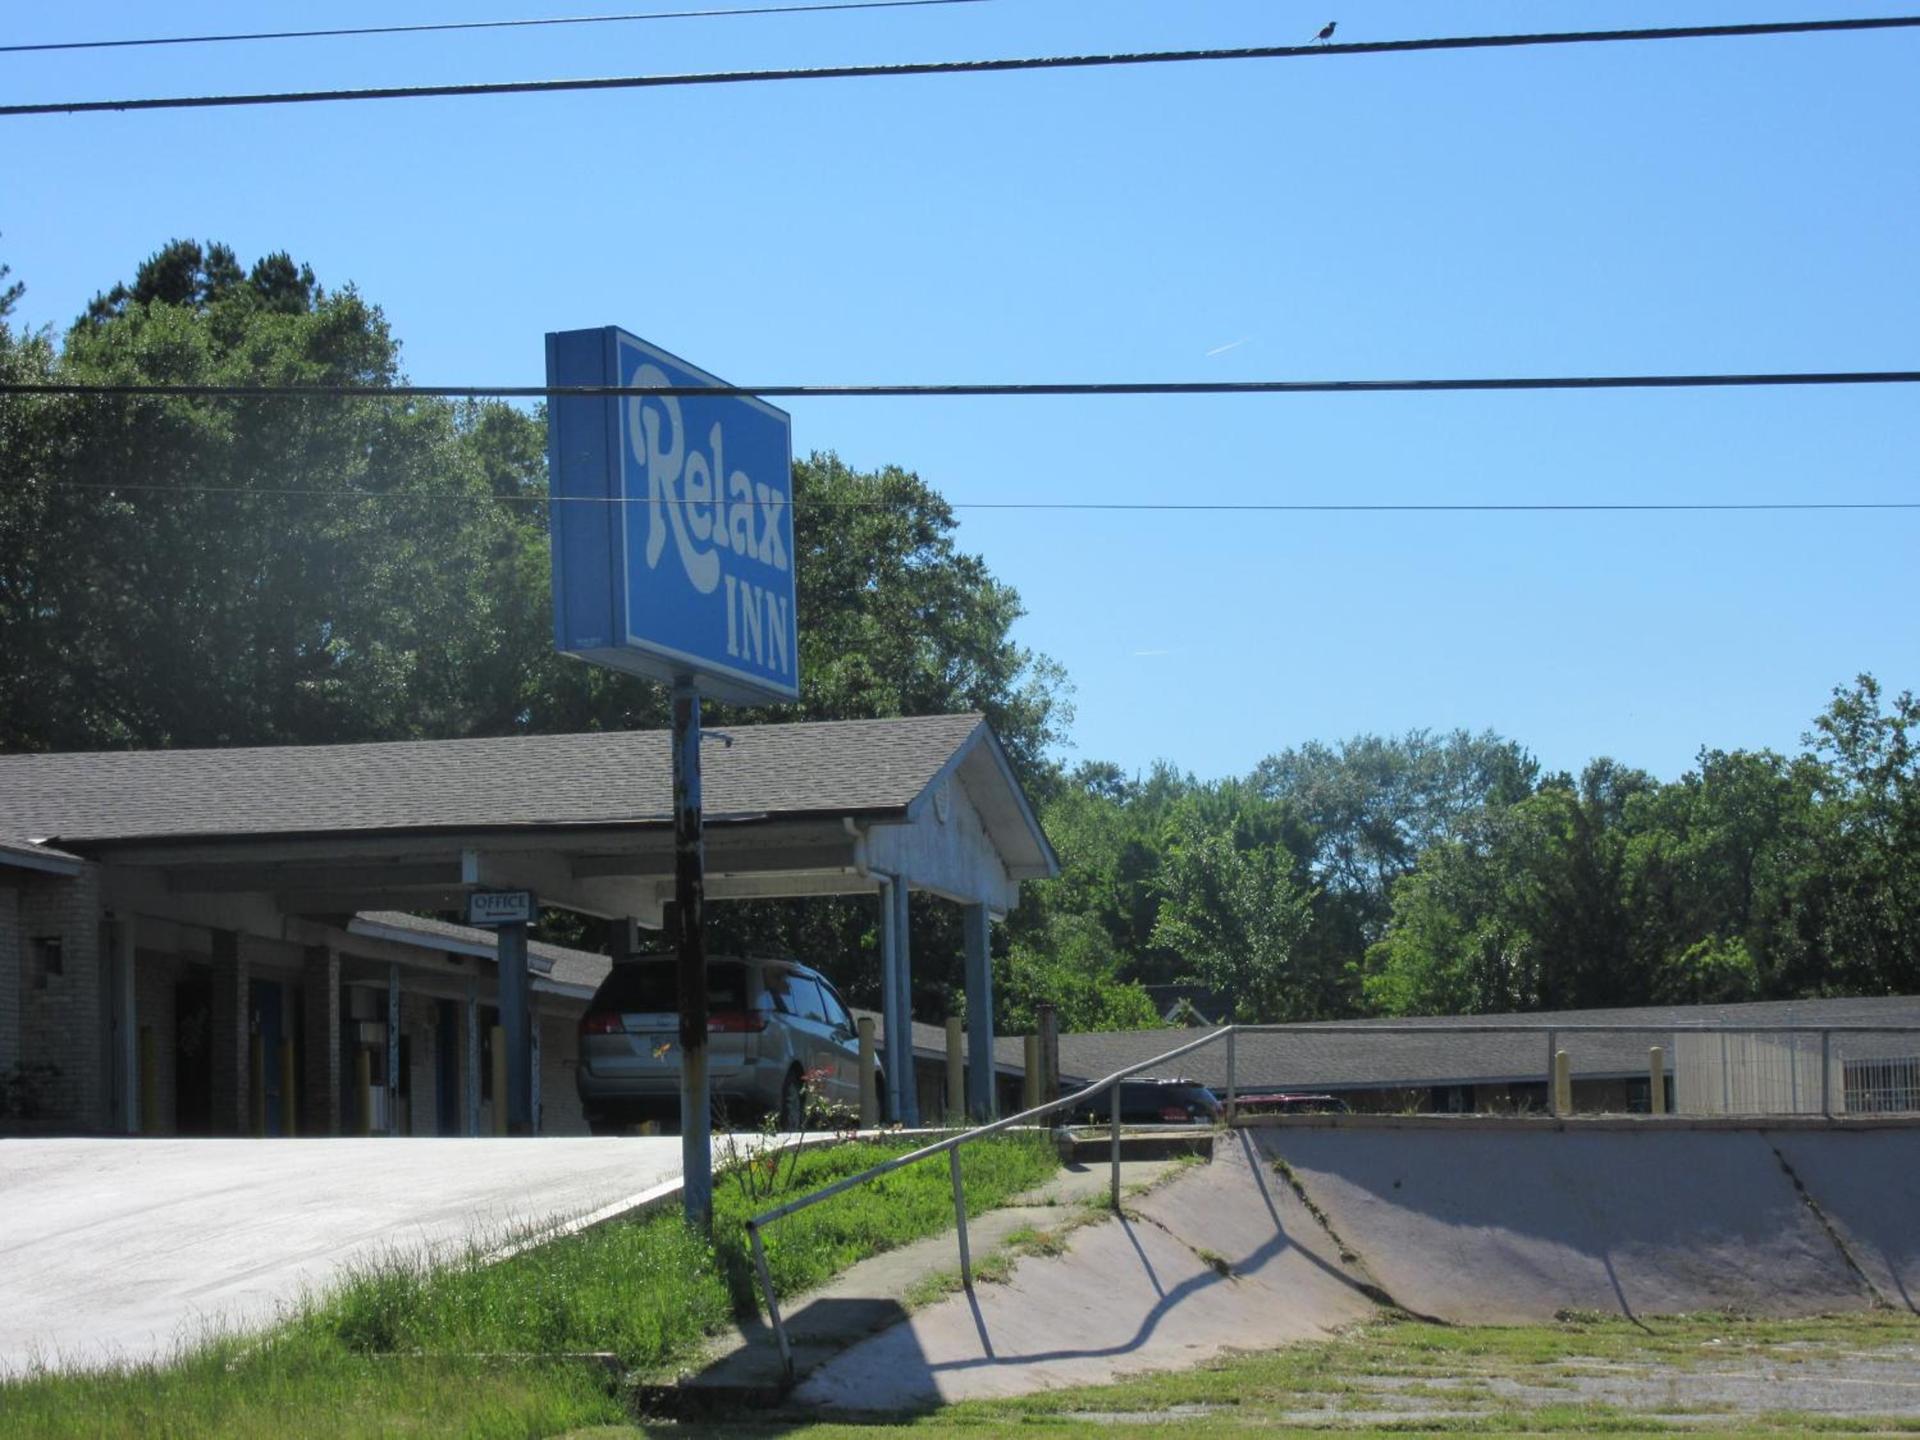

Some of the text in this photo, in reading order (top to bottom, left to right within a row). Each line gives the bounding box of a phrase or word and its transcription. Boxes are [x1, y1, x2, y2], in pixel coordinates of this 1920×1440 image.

[628, 363, 788, 594] Relax
[724, 574, 788, 675] INN
[474, 894, 527, 909] OFFICE
